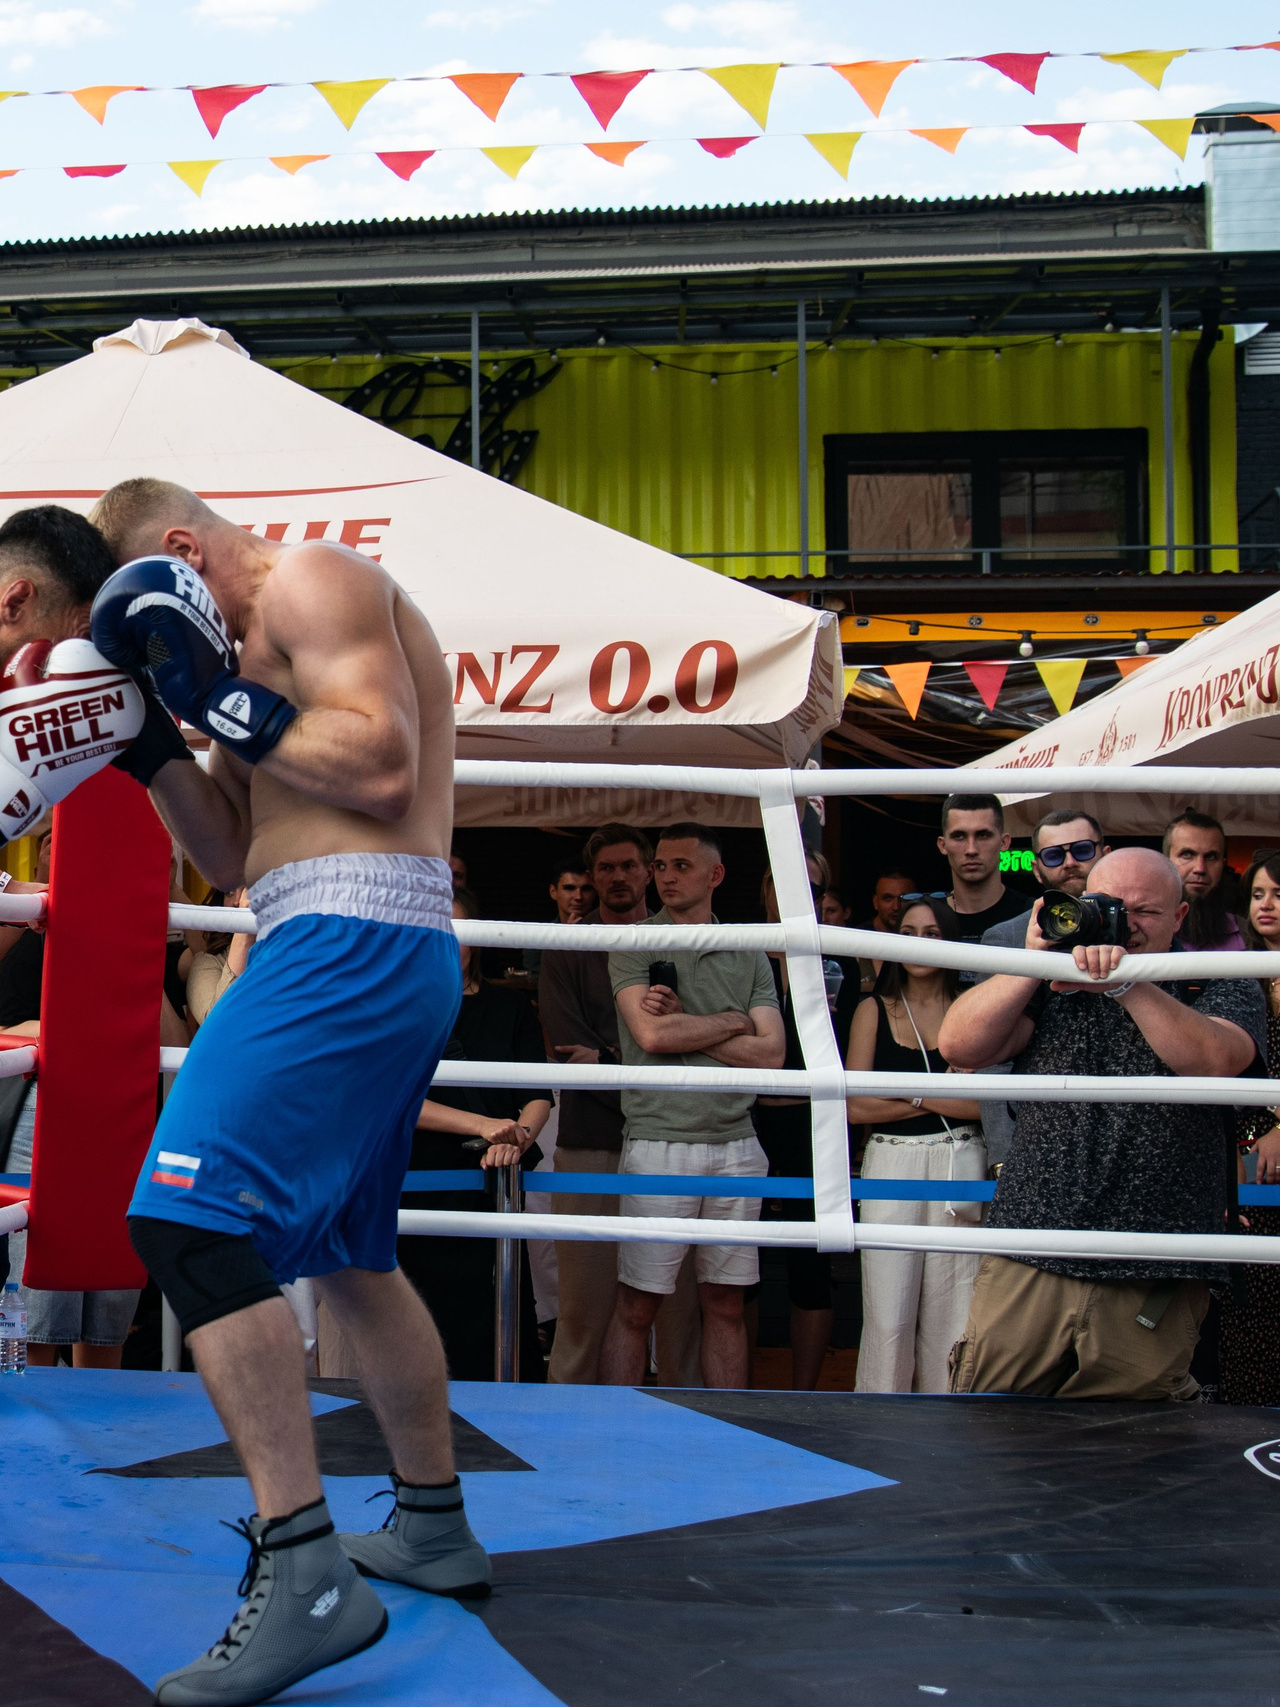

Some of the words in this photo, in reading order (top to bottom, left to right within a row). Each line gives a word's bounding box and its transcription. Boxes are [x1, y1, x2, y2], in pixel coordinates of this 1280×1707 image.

[588, 640, 738, 714] 0.0
[8, 689, 125, 738] GREEN
[14, 718, 114, 763] HILL
[54, 758, 65, 768] BE
[65, 752, 85, 764] YOUR
[85, 746, 102, 758] BEST
